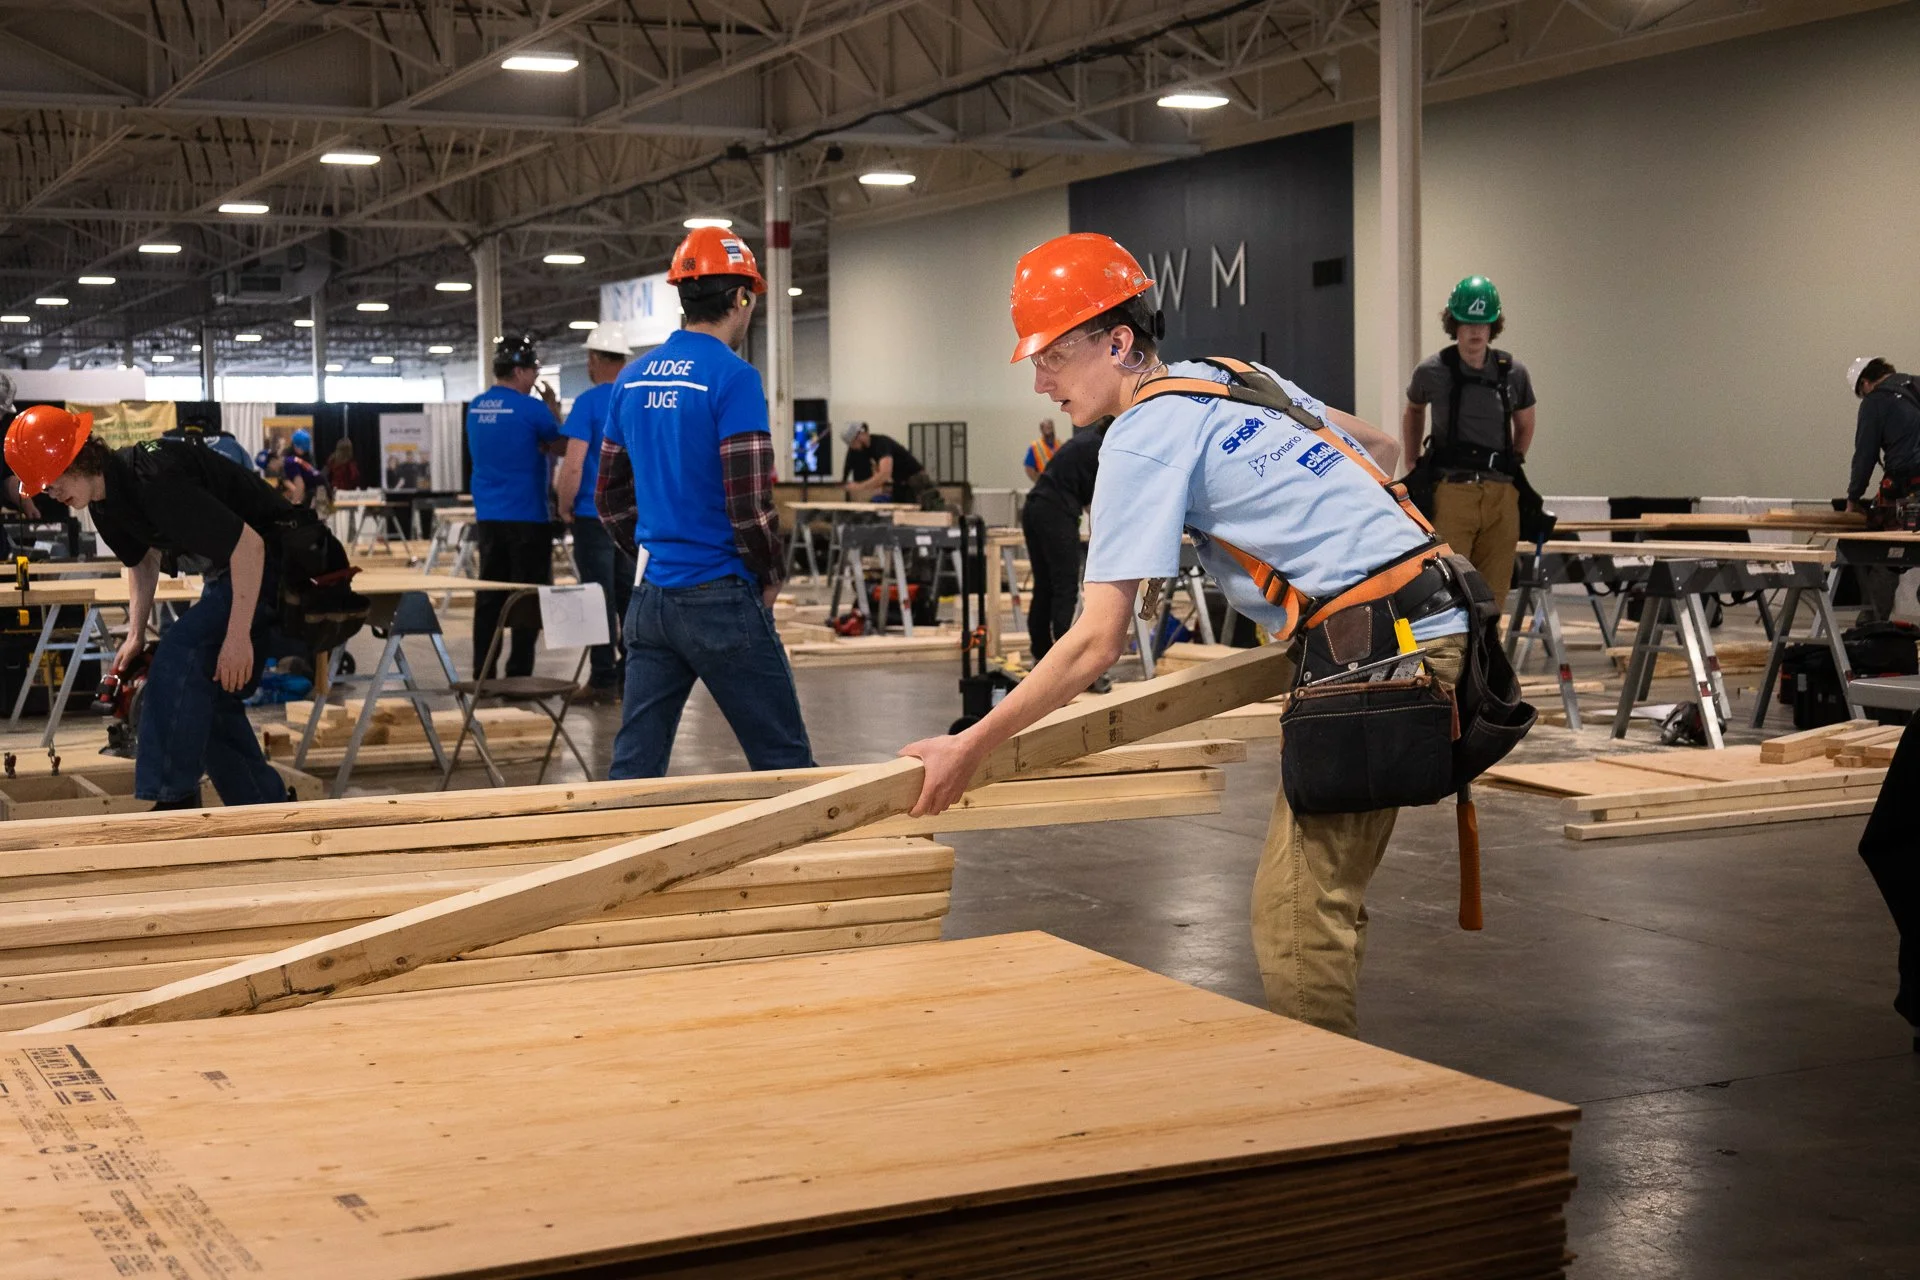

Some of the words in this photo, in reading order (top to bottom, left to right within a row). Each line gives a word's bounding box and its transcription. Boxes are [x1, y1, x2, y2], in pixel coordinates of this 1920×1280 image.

[642, 360, 695, 376] JUDGE
[644, 391, 679, 408] JUGE
[1221, 417, 1266, 455] SHSM
[1270, 435, 1302, 462] Ontario
